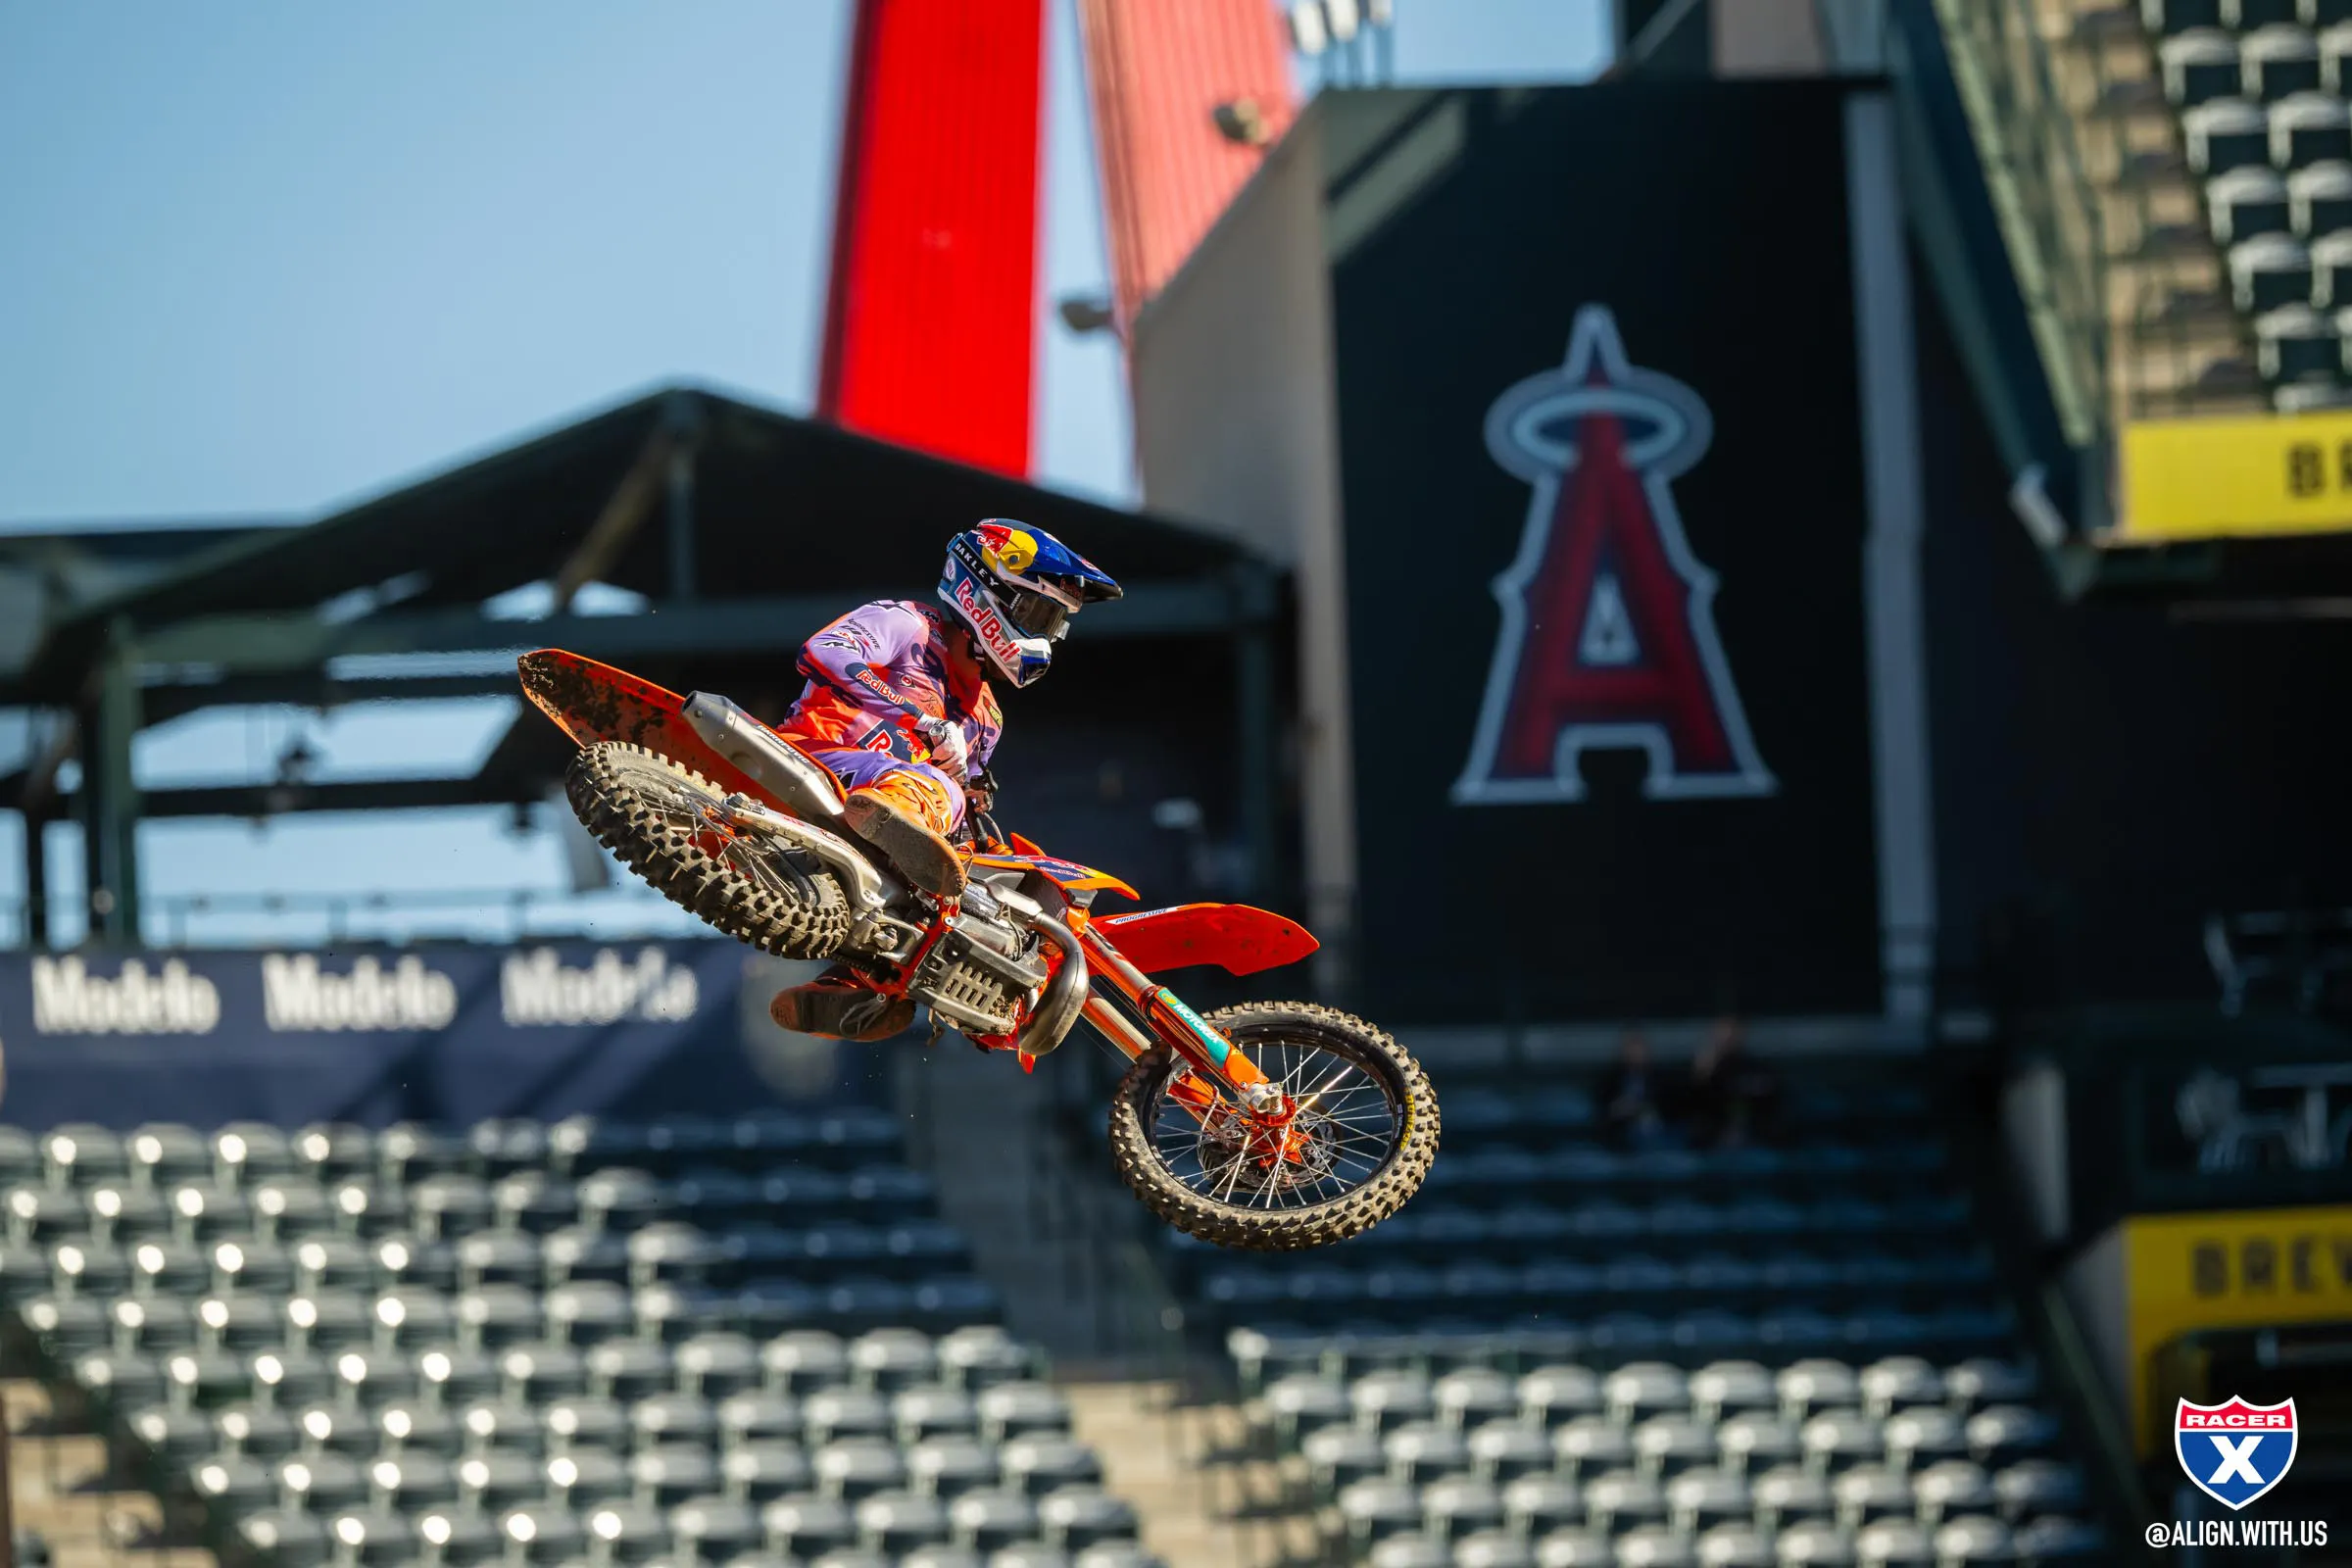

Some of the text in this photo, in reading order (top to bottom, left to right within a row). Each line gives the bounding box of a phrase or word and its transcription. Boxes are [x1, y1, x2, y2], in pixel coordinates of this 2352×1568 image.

[955, 543, 999, 587] OAKLEY
[1115, 906, 1170, 925] PROGRESSIVE
[1173, 1004, 1220, 1044] MOTOREX
